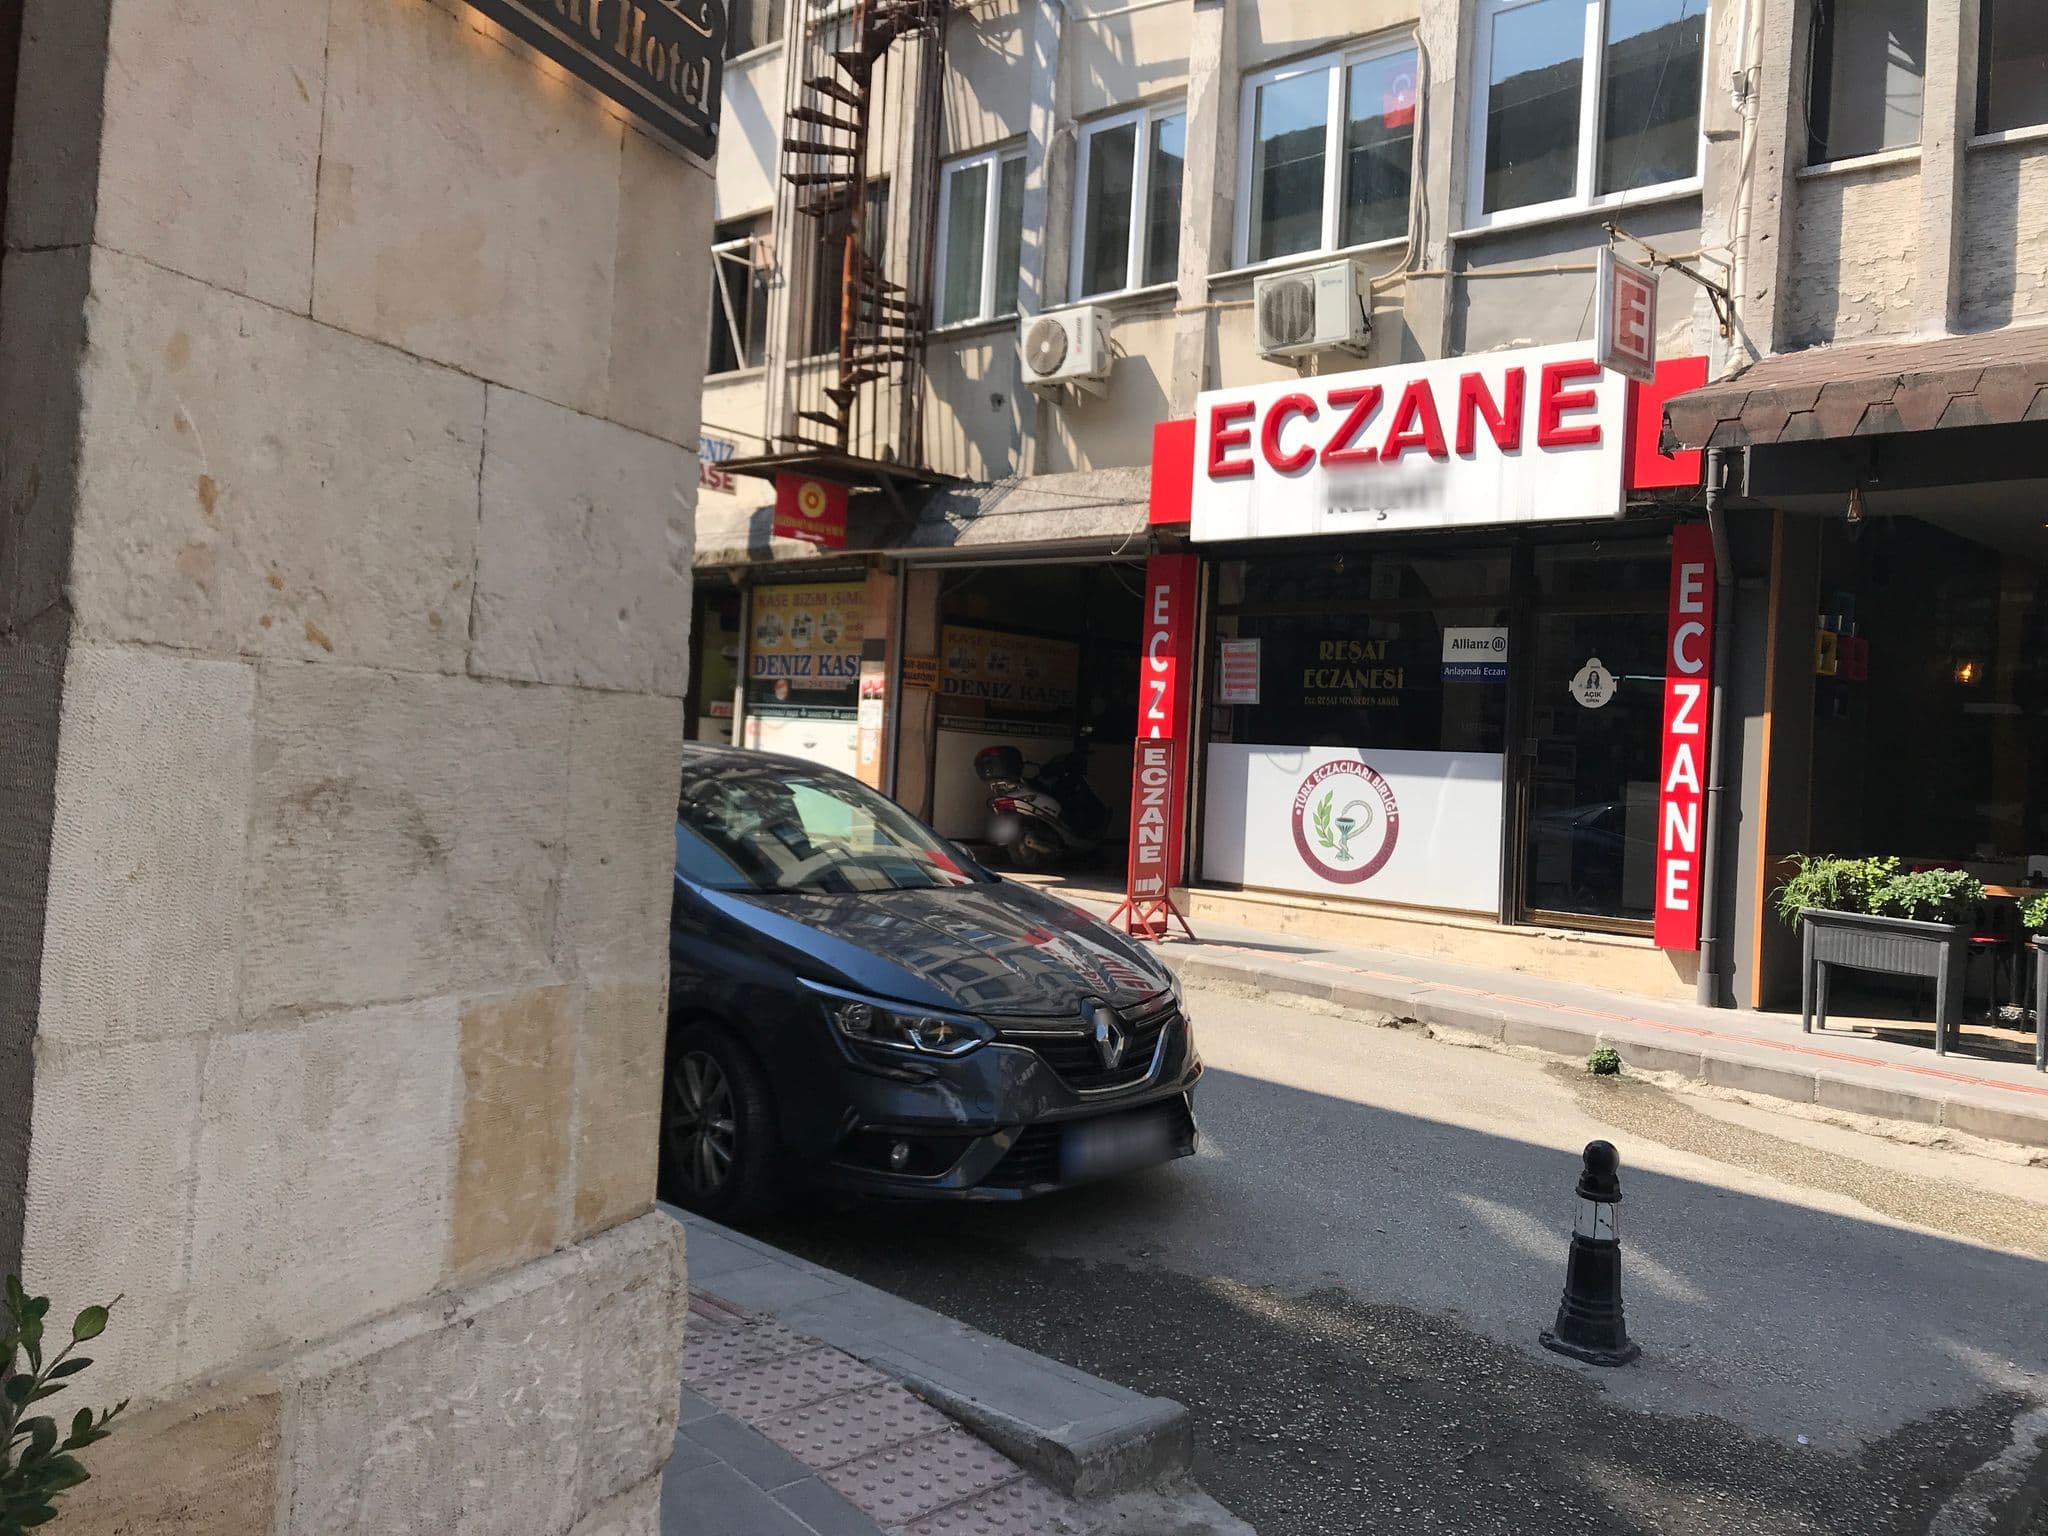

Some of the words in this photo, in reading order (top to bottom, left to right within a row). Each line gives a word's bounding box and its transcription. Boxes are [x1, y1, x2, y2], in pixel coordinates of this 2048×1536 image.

[614, 0, 712, 114] Hotel
[1208, 359, 1601, 478] ECZANE
[1319, 639, 1389, 663] REŞAT
[1451, 638, 1490, 649] Allianz
[1303, 667, 1405, 689] ECZANESİ
[1443, 666, 1481, 677] Anlaşmalı
[1483, 666, 1506, 676] Eczan
[1664, 563, 1705, 911] ECZANE
[1138, 748, 1168, 864] ECZANE
[1295, 779, 1315, 810] TÜRK
[1312, 761, 1373, 783] ECZACILARI
[1371, 775, 1399, 816] BİRLİĞİ
